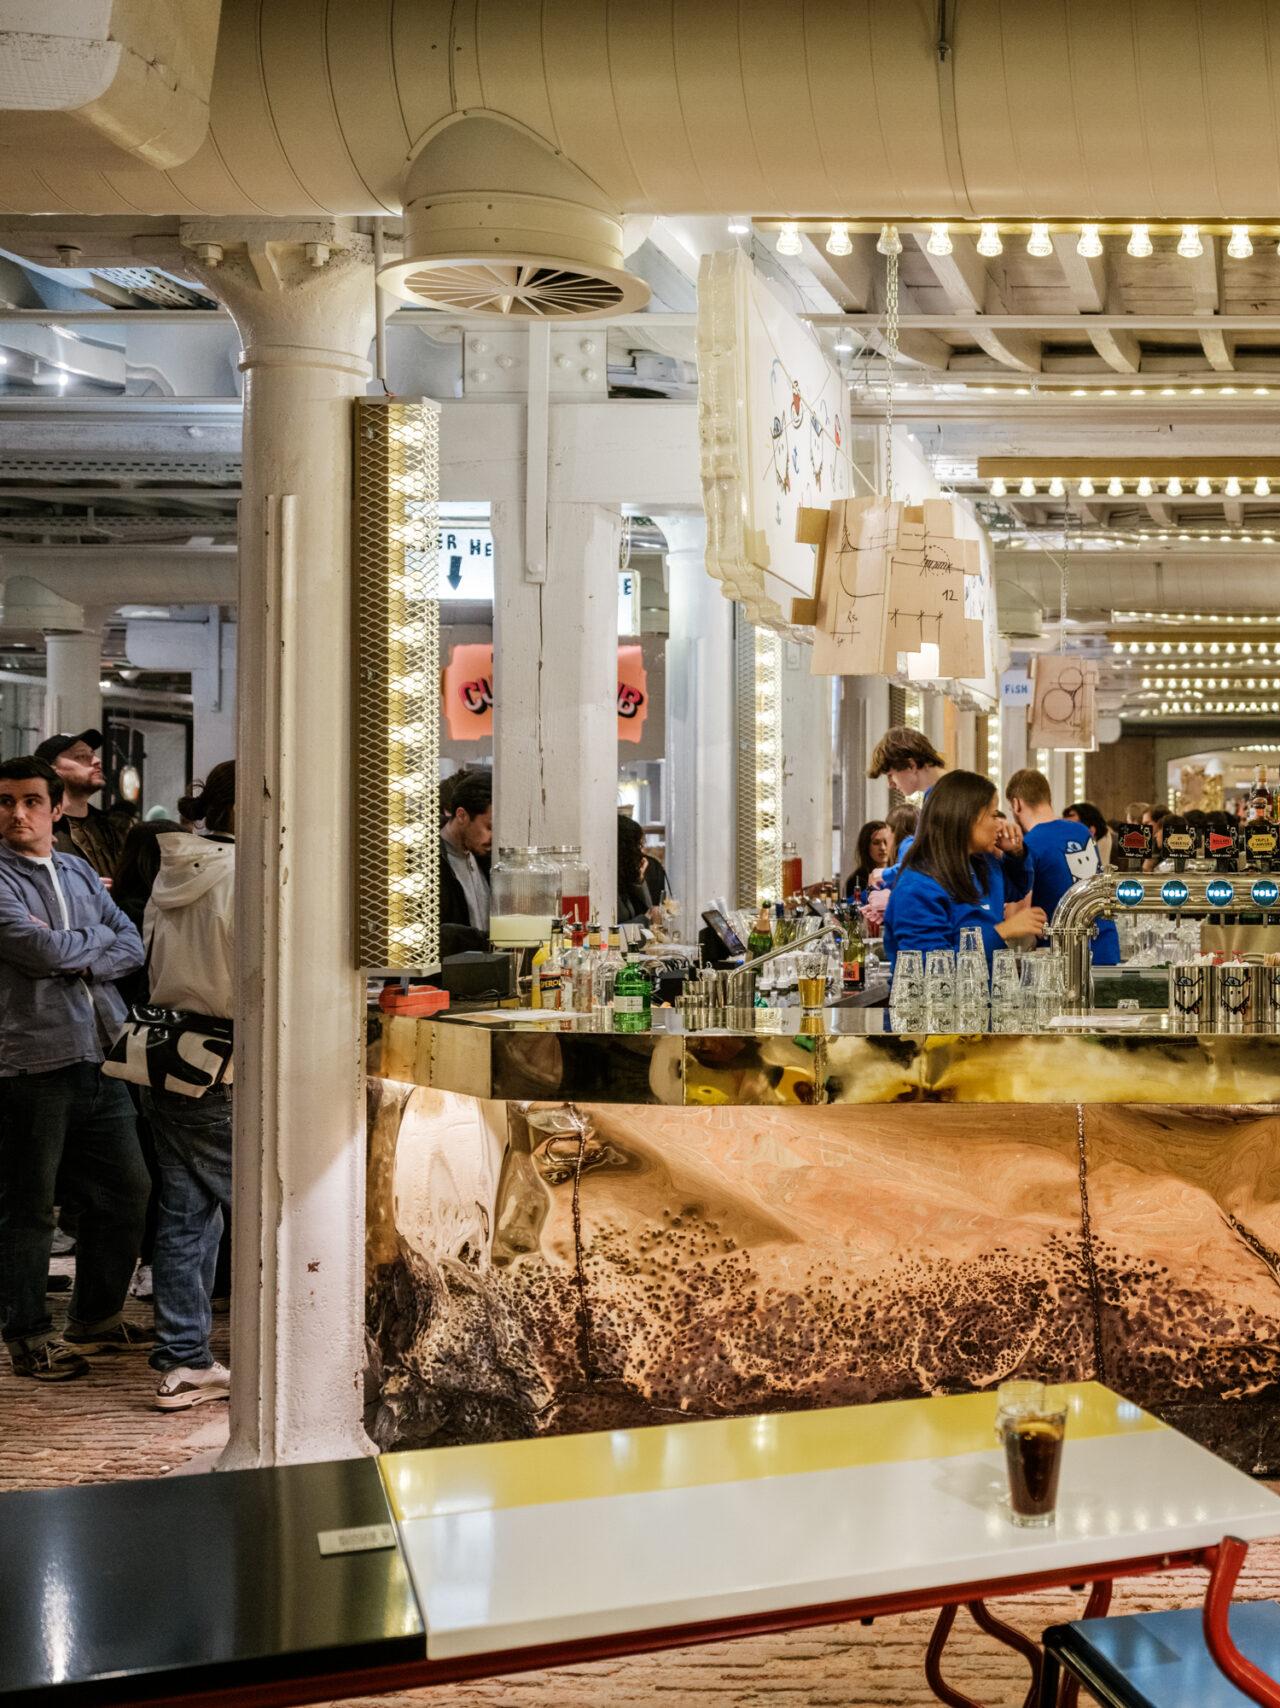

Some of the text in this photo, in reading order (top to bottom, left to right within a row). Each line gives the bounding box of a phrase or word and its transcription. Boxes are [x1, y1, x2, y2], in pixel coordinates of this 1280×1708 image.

[942, 589, 959, 601] 12
[1118, 889, 1142, 897] WOLF
[1163, 889, 1187, 897] WOLF
[1208, 889, 1232, 897] WOLF
[1253, 889, 1278, 897] WOLF
